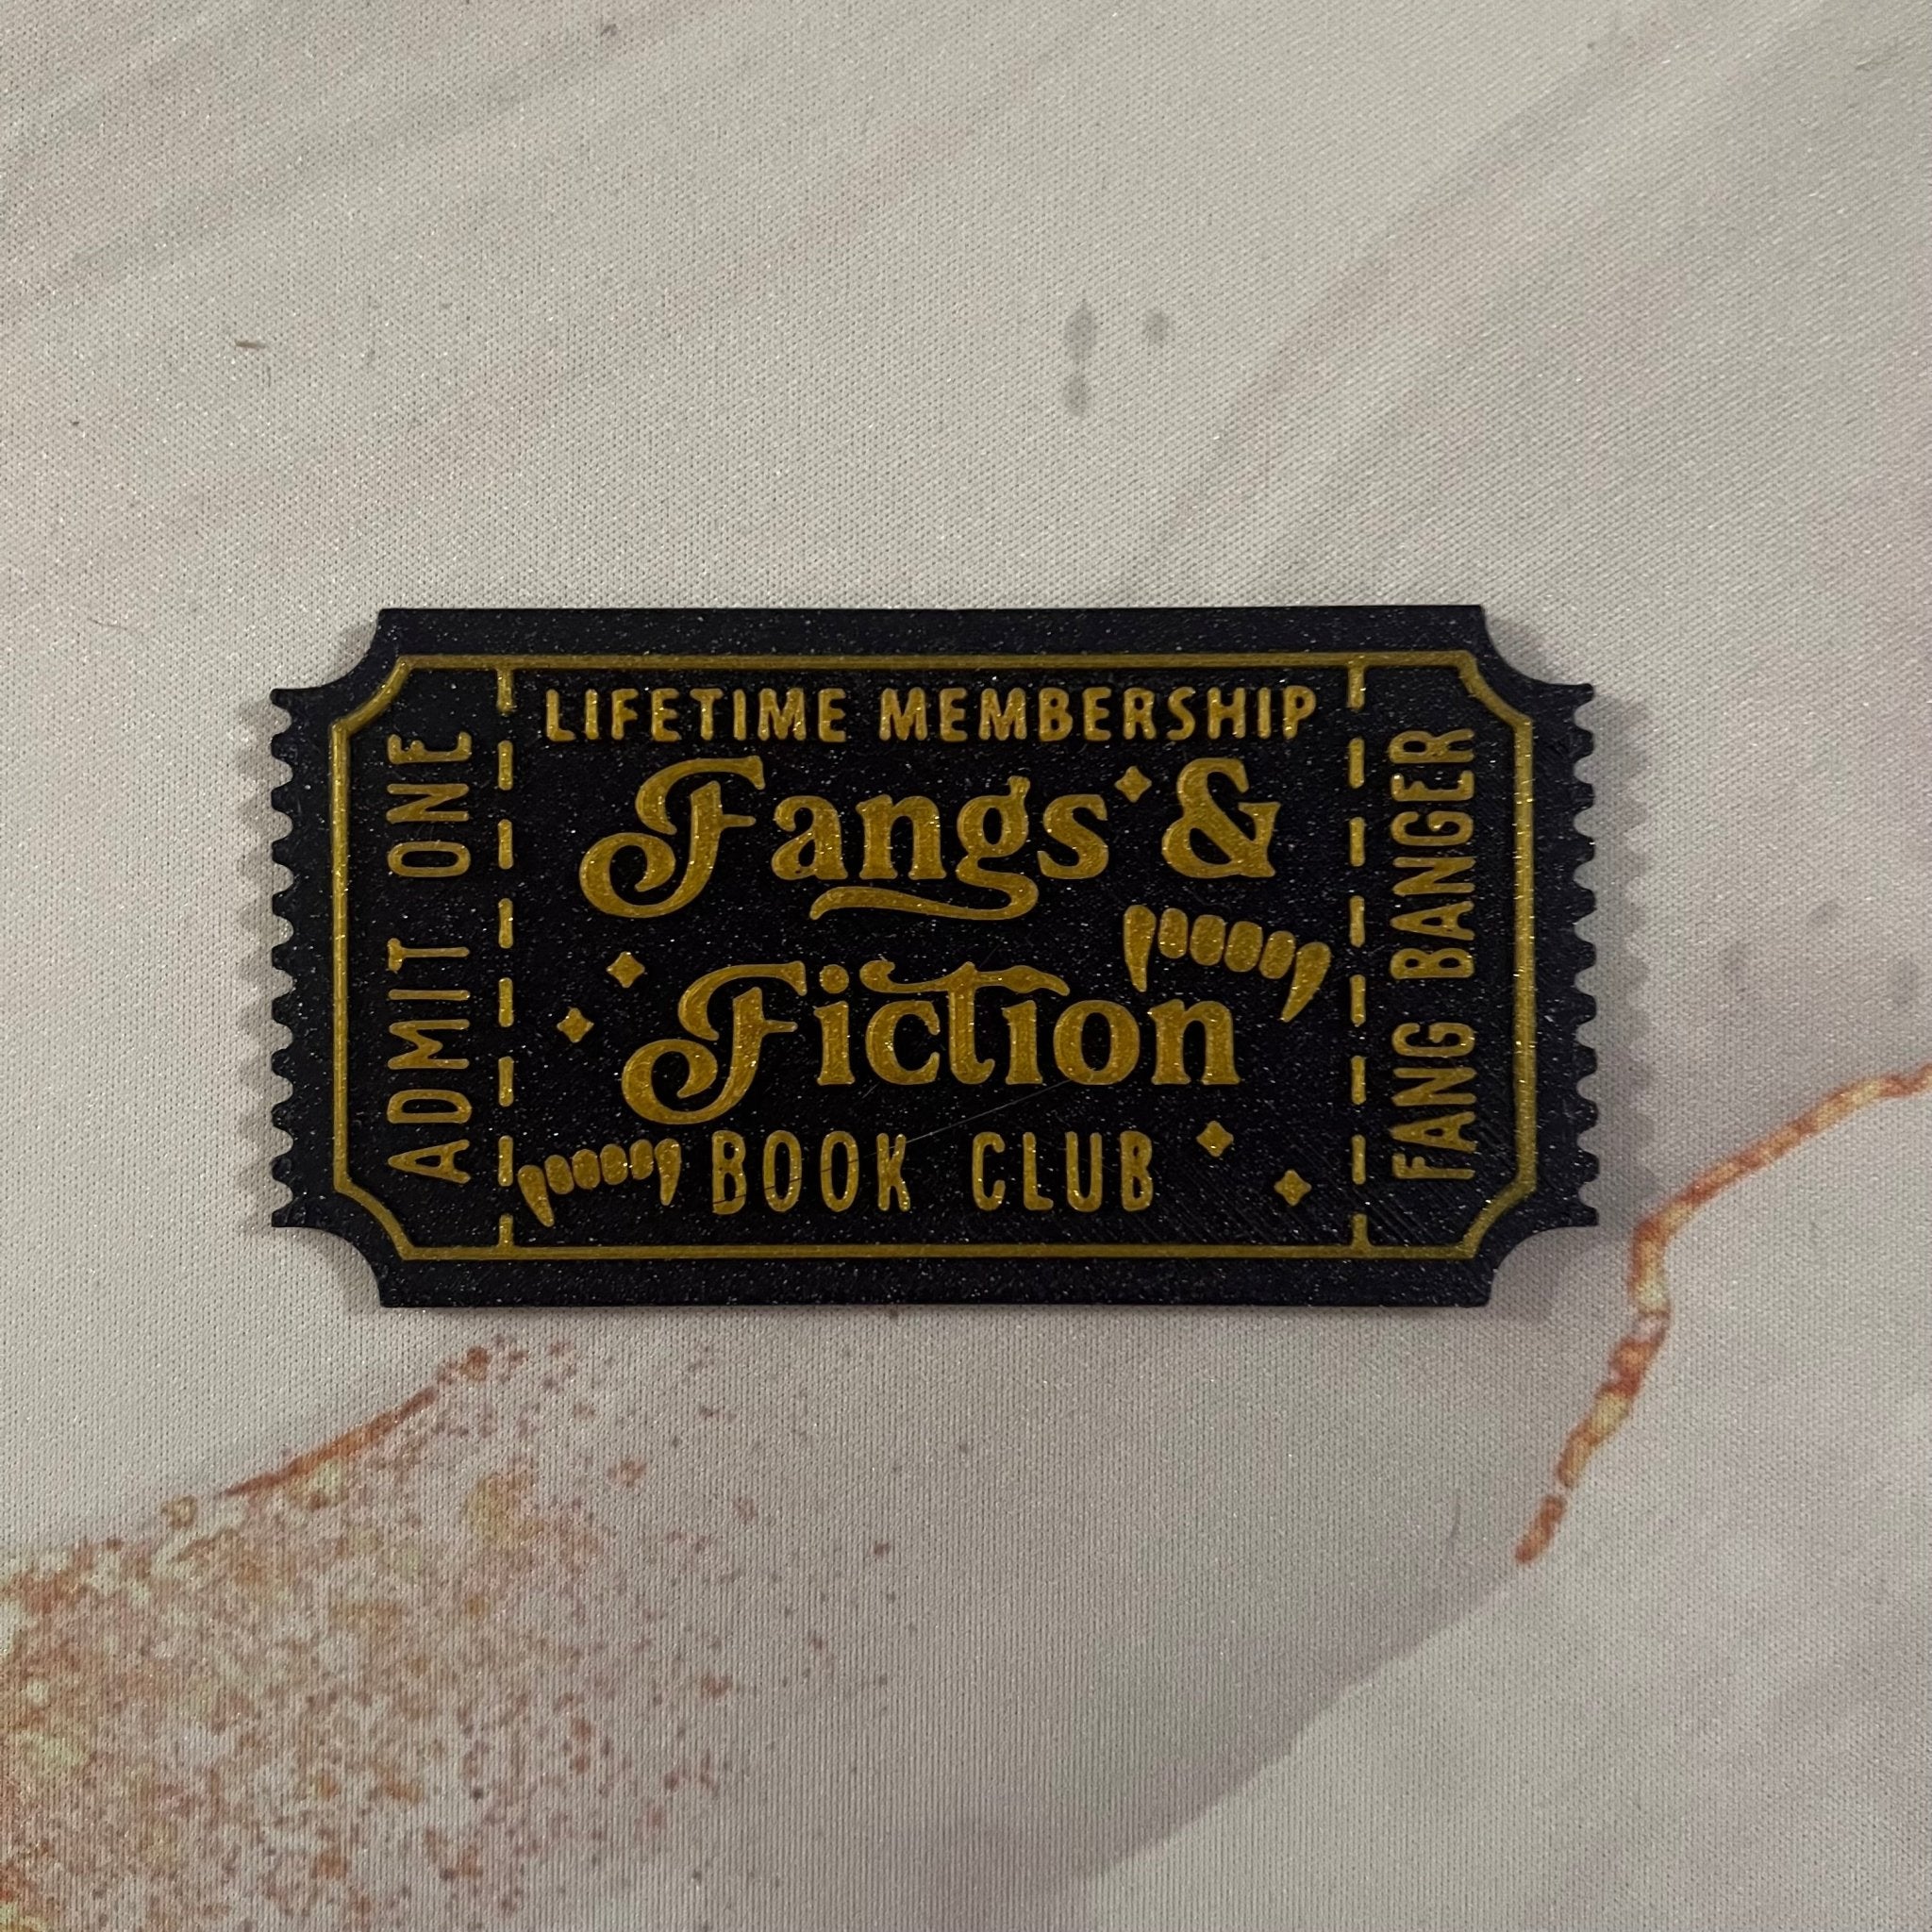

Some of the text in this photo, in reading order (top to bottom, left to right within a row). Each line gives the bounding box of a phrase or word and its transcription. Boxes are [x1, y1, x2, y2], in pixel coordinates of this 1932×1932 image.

[544, 686, 1318, 743] LIFETIME MEMBERSHIP
[578, 754, 1280, 922] Fangs &
[386, 732, 473, 1185] ADMIT ONE
[1387, 729, 1476, 1179] FANG BANGER
[620, 960, 1241, 1125] Fiction
[710, 1130, 1154, 1216] BOOK CLUB
